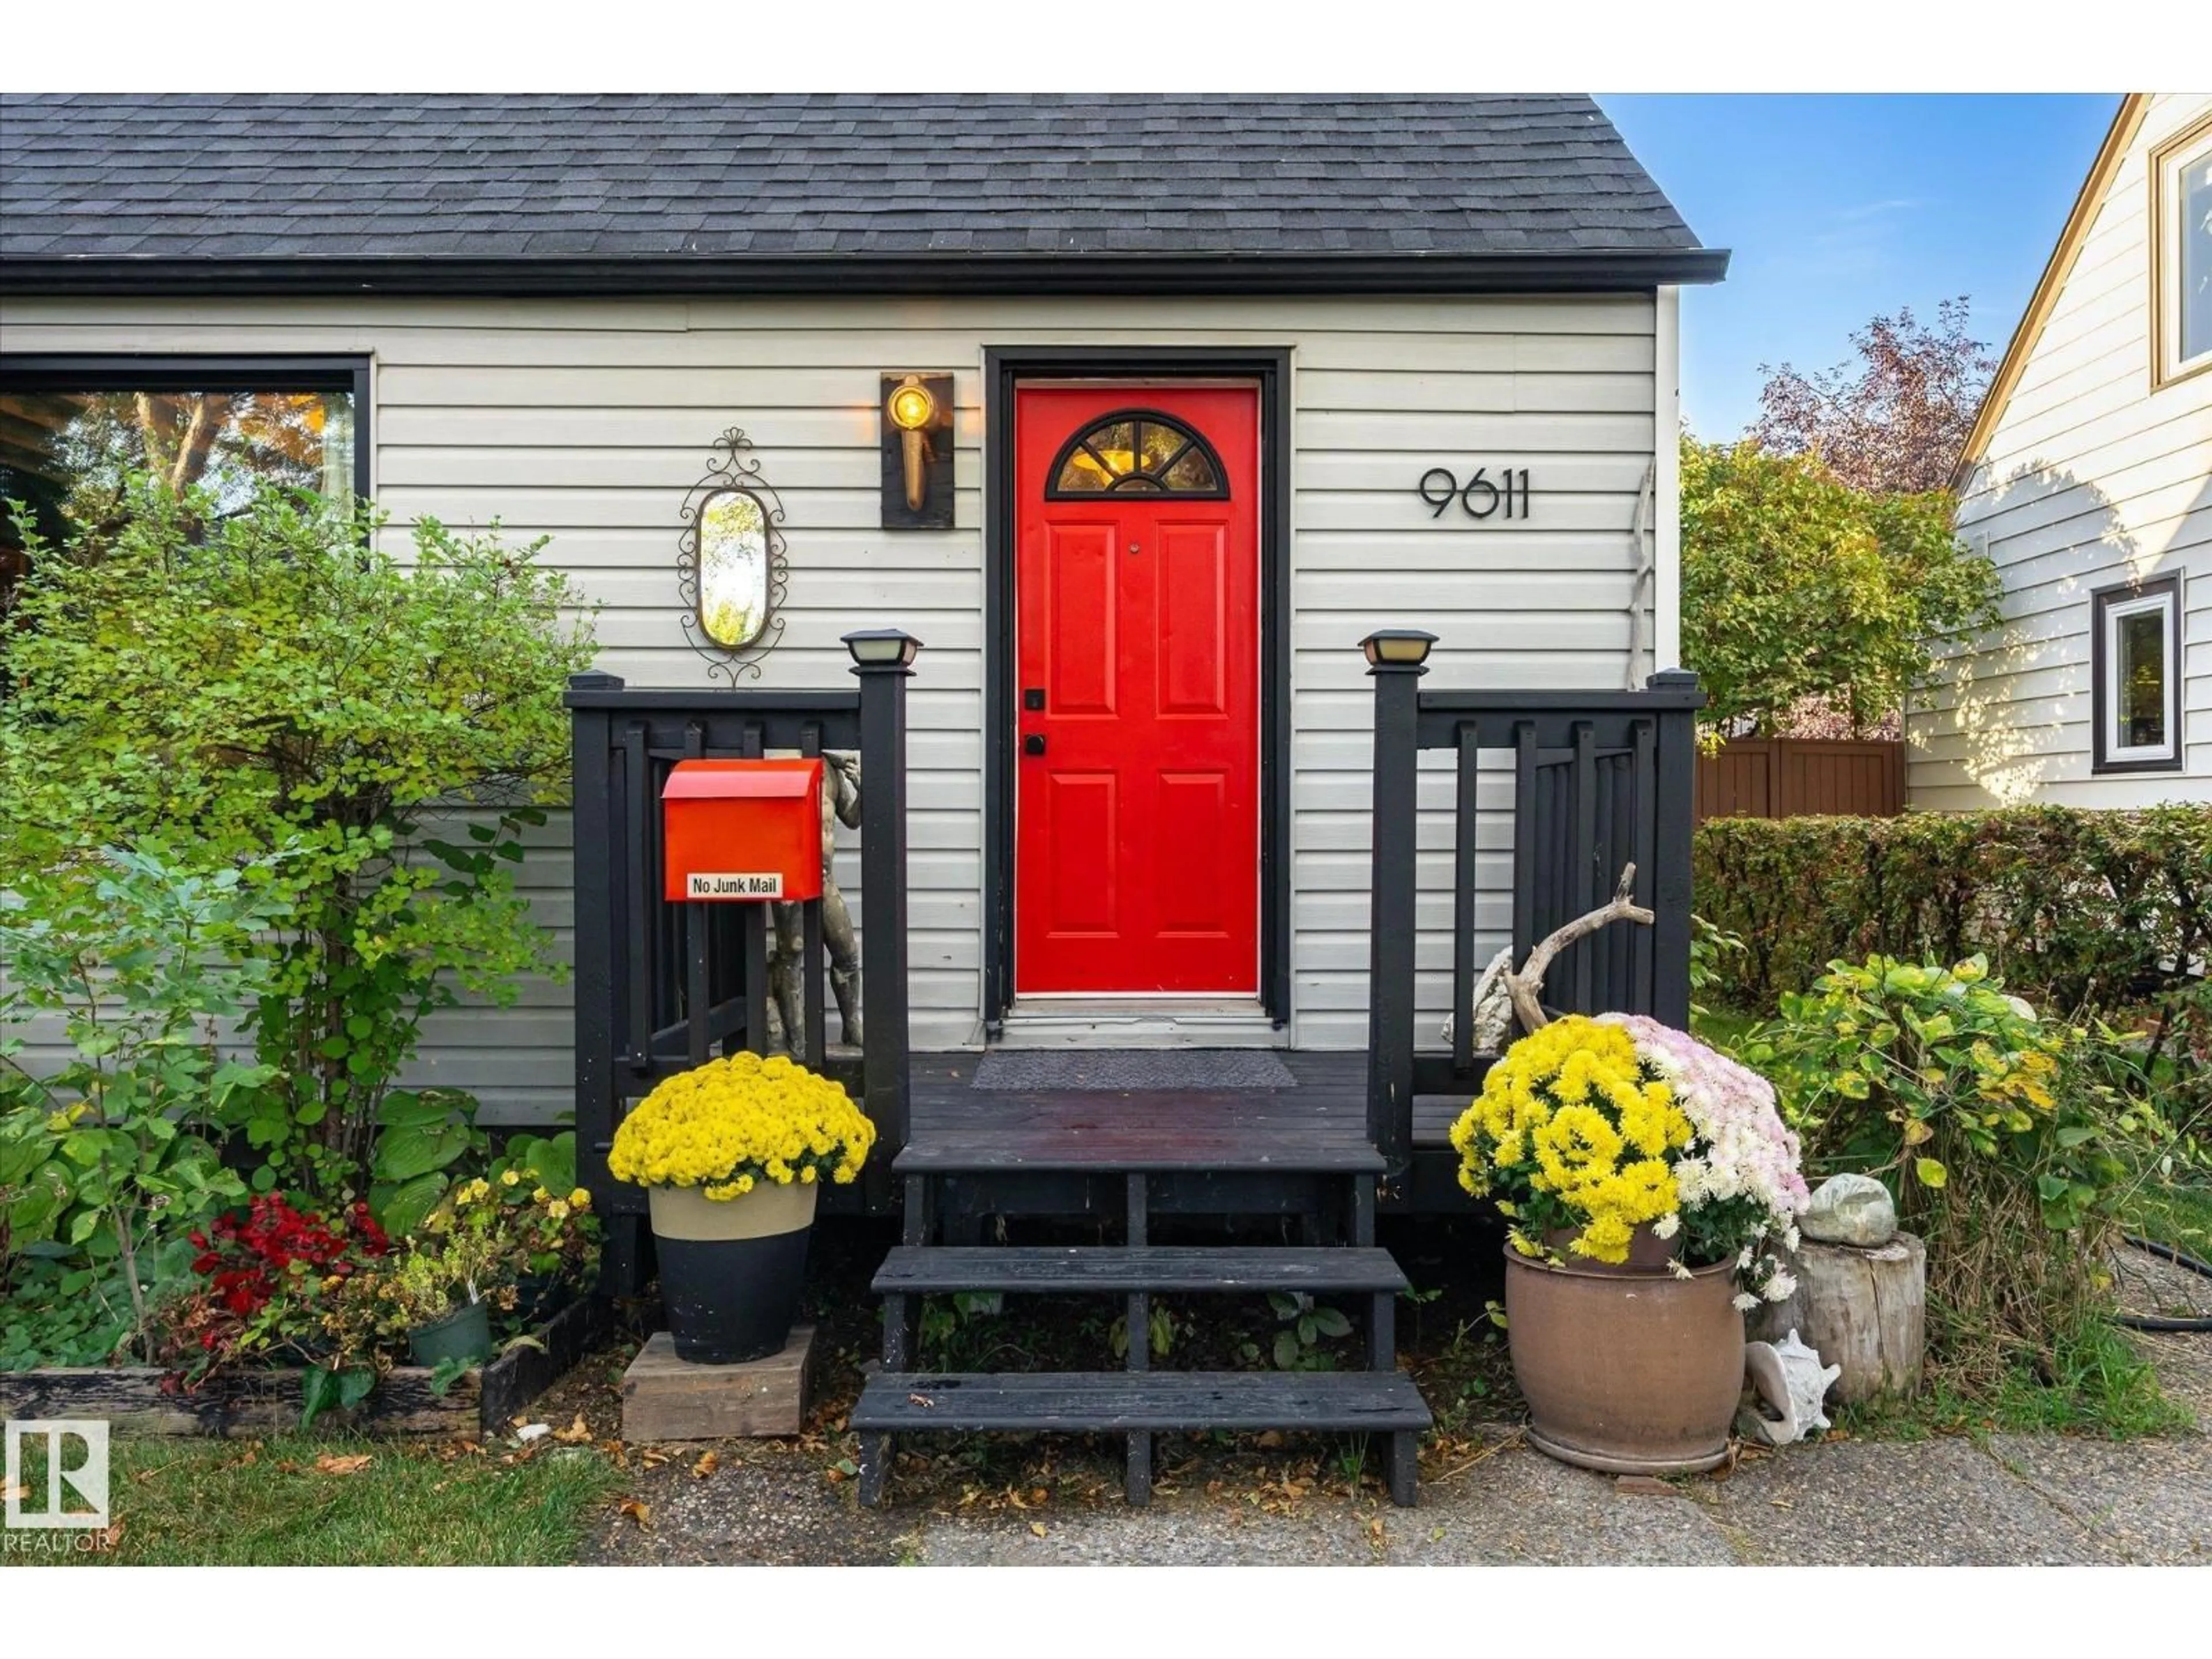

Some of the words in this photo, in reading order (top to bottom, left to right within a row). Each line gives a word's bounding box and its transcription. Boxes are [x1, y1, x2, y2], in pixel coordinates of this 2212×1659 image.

[1419, 467, 1529, 518] 9611
[694, 878, 710, 893] No
[714, 878, 745, 893] Junk
[749, 878, 777, 893] Mail
